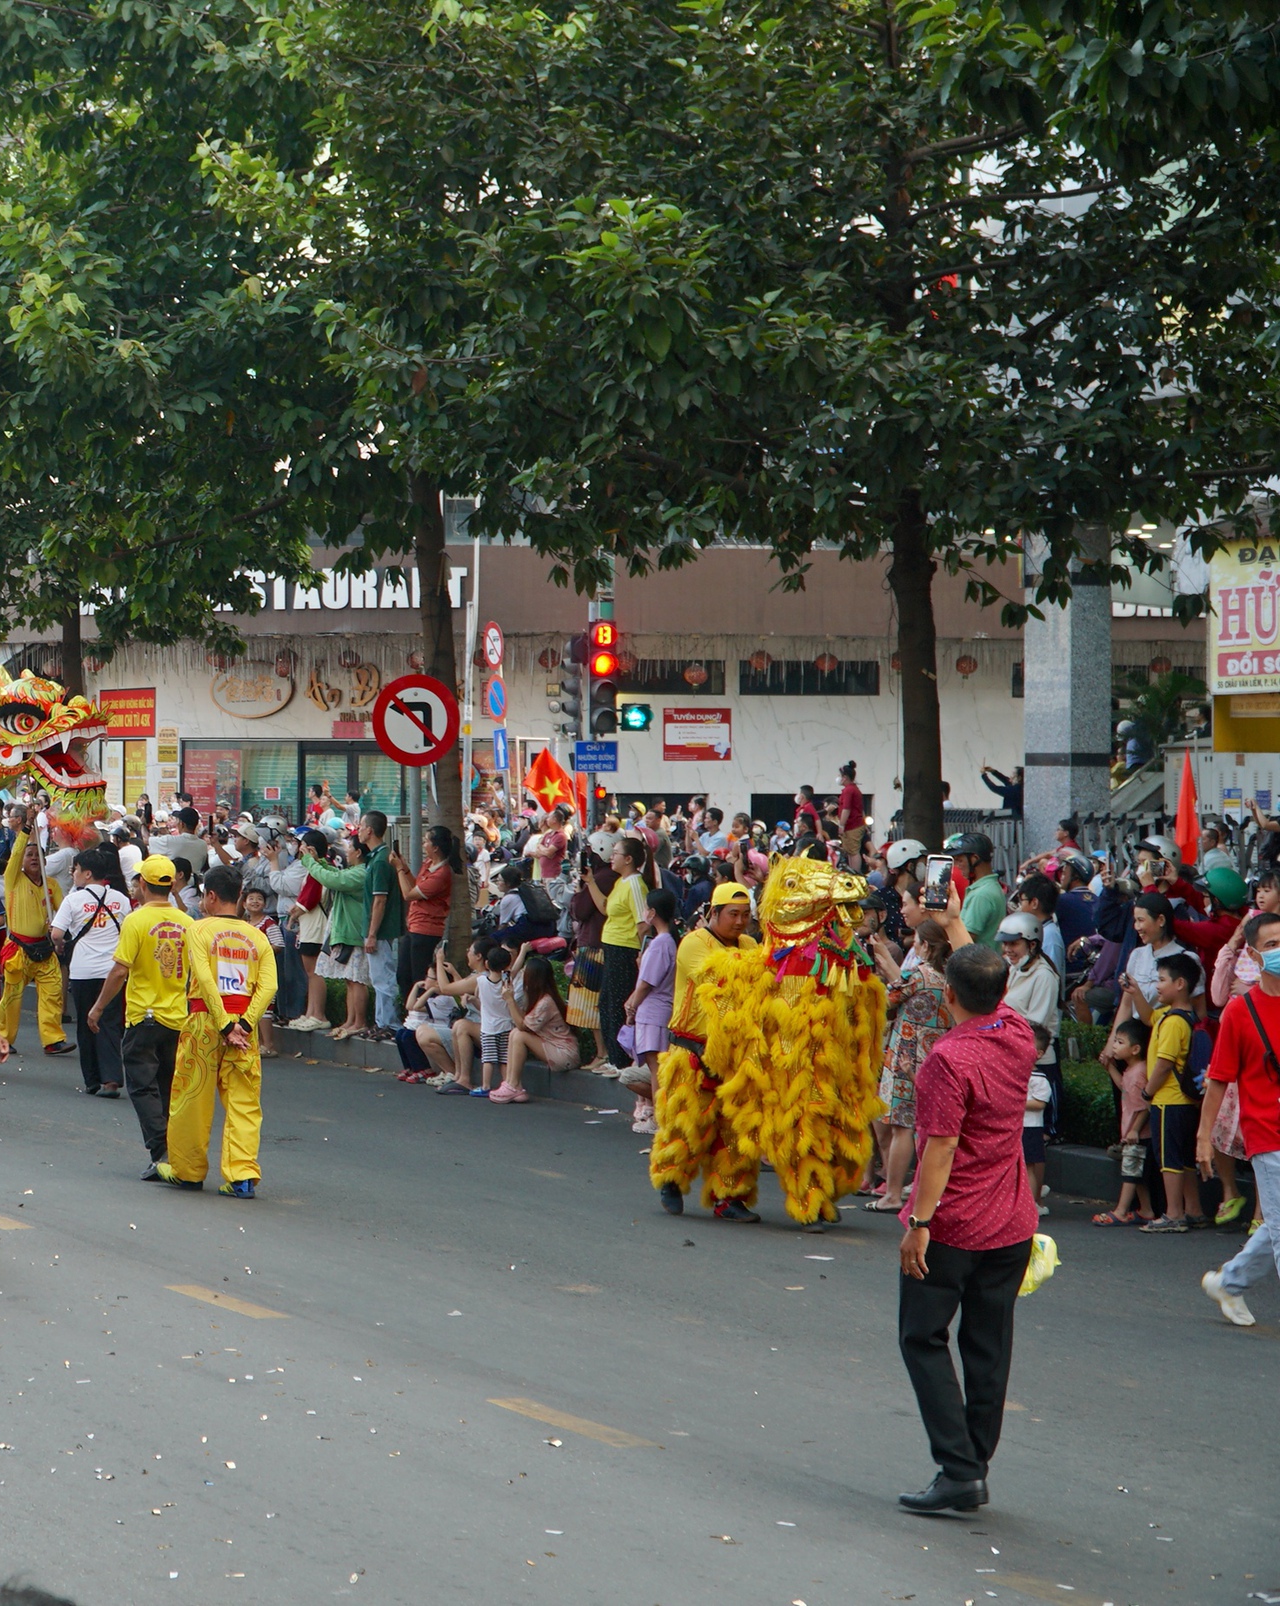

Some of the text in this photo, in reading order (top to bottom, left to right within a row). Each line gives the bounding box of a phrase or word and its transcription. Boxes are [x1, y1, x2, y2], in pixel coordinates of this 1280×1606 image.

[1238, 546, 1280, 568] ĐẠ
[1218, 570, 1280, 646] HỮ
[598, 626, 612, 644] 13
[1227, 652, 1259, 675] ĐỔI
